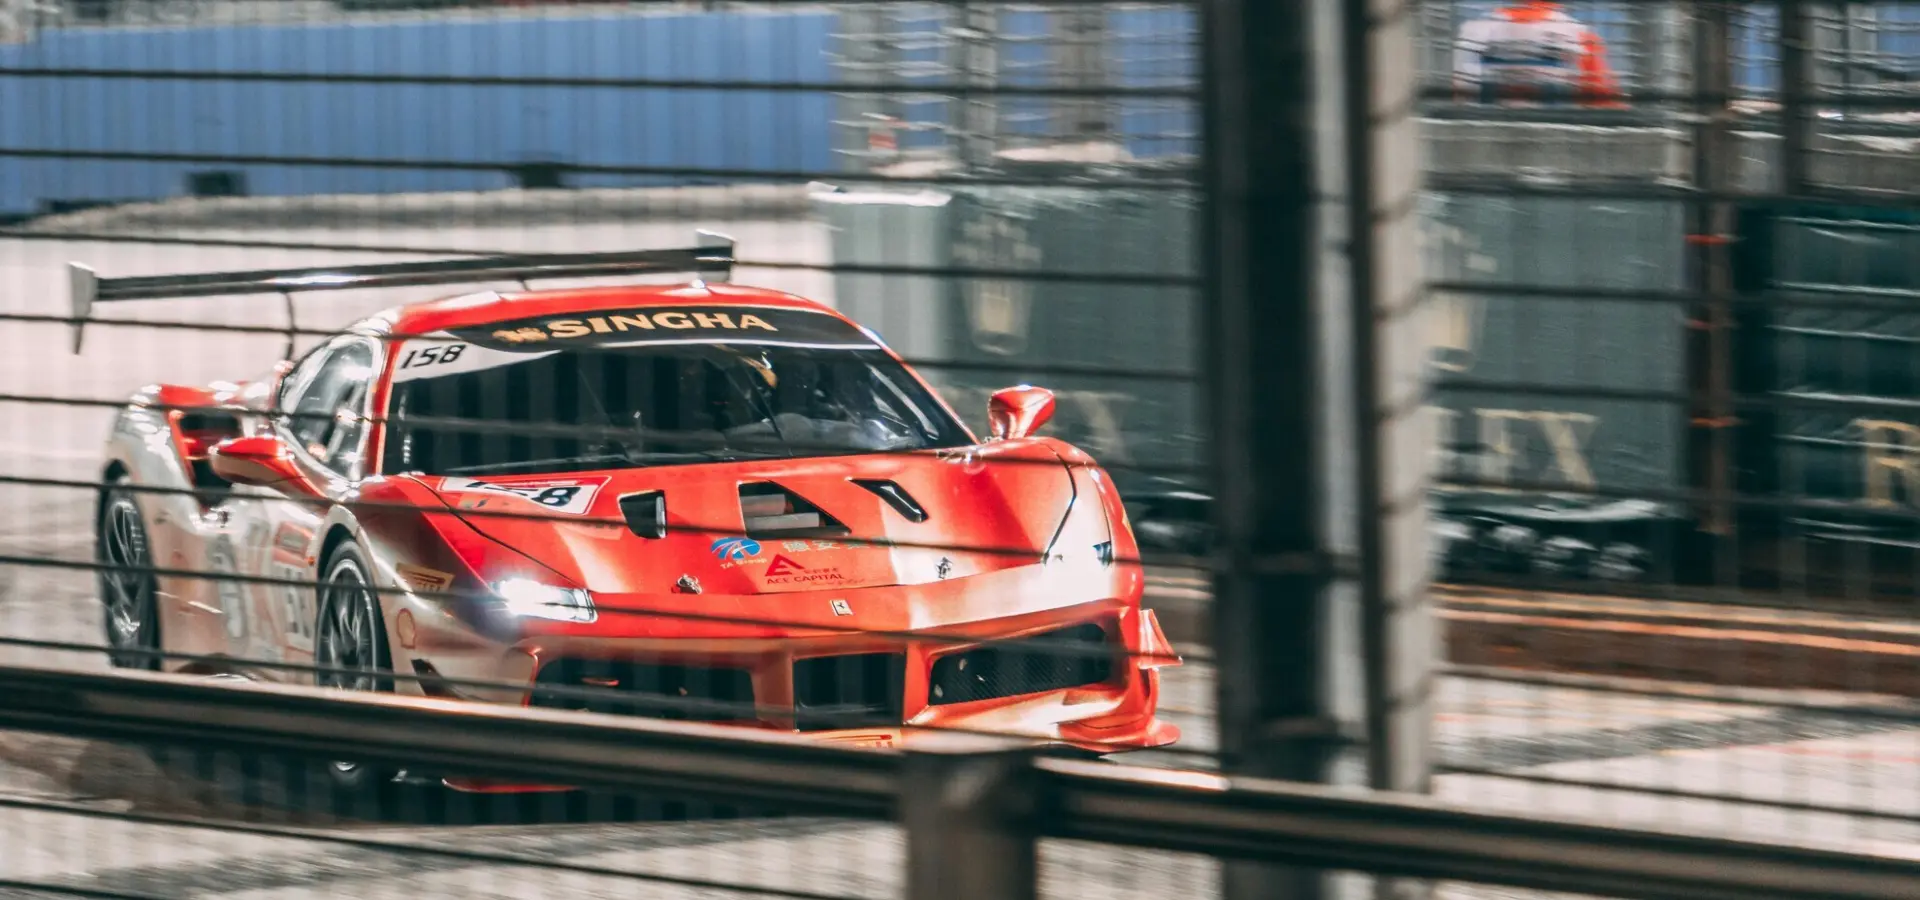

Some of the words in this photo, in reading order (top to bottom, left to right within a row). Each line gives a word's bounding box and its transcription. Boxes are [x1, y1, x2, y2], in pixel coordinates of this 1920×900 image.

[547, 311, 779, 339] SINGHA
[401, 344, 467, 369] 158
[766, 577, 790, 585] ACE
[793, 573, 846, 583] CAPITAL
